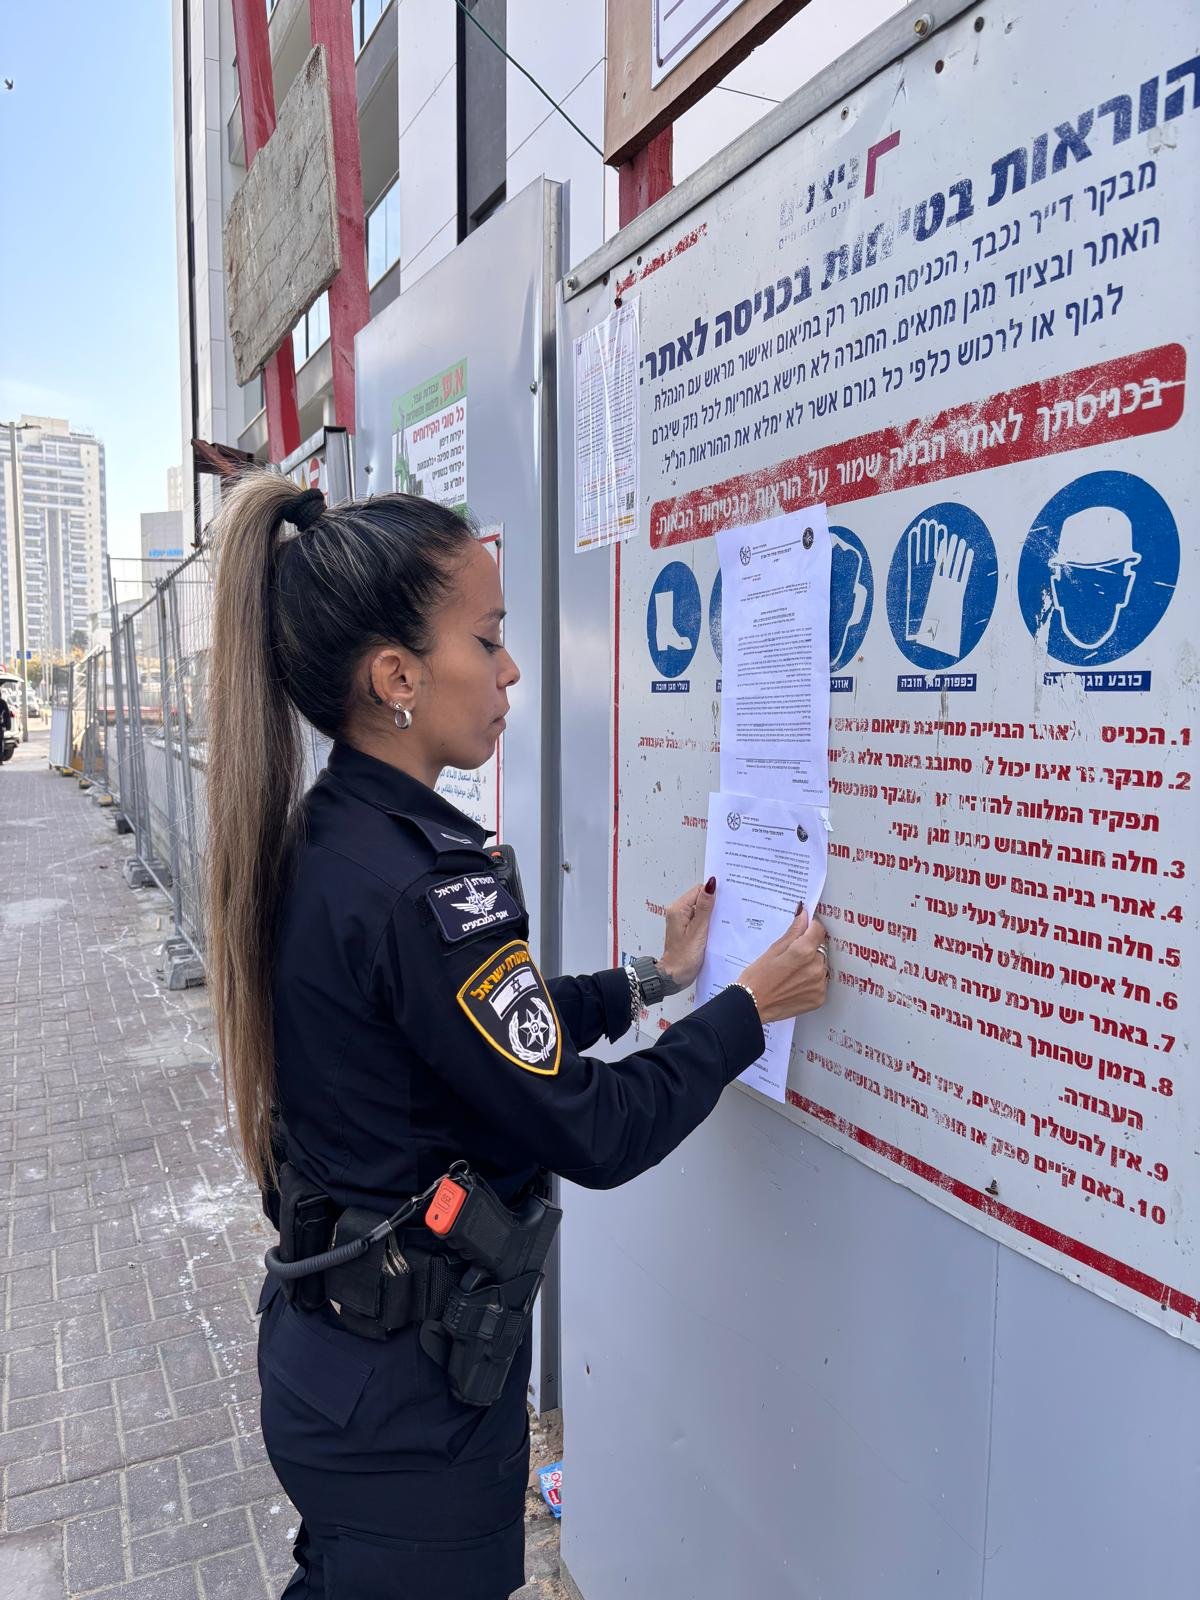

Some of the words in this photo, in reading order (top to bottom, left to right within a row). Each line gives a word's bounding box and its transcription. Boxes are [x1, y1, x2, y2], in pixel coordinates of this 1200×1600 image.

[988, 55, 1200, 206] הוראות
[1085, 161, 1156, 216] מבקר
[1030, 194, 1073, 233] דייר
[964, 220, 1020, 273] נכבד,
[1084, 217, 1159, 266] האתר
[895, 251, 957, 298] הכניסה
[1005, 250, 1072, 297] ובציוד
[715, 266, 812, 347] בכניסה
[851, 283, 888, 317] תותר
[964, 282, 995, 324] מגן
[1066, 283, 1123, 336] לגוף
[826, 304, 844, 337] רק
[893, 299, 956, 345] מתאים.
[1032, 310, 1054, 342] או
[777, 316, 820, 353] בתיאום
[958, 319, 1022, 365] לרכוש
[640, 317, 708, 385] לאתר:
[739, 339, 772, 370] ואישור
[835, 329, 886, 368] החברה
[705, 360, 734, 387] מראש
[811, 350, 829, 378] לא
[910, 350, 950, 382] כלפי
[688, 375, 700, 396] עם
[774, 364, 805, 394] תישא
[883, 367, 902, 392] כל
[655, 384, 684, 411] הנהלת
[725, 380, 768, 416] באחריות
[809, 391, 837, 419] אשר
[844, 377, 875, 408] גורם
[702, 398, 720, 424] לכל
[787, 402, 803, 428] לא
[1037, 377, 1162, 435] בכניסתך
[653, 419, 679, 445] שיגרם
[683, 412, 697, 438] נזק
[734, 426, 749, 448] את
[754, 413, 781, 440] ימלא
[958, 409, 1023, 452] לאתר
[662, 450, 685, 474] הנ"ל.
[689, 434, 730, 464] ההוראות
[836, 452, 880, 485] שמור
[808, 466, 828, 498] על
[698, 493, 749, 523] הבטיחות
[656, 507, 693, 537] הבאות:
[901, 678, 922, 688] חובה
[944, 677, 973, 688] כפפות
[1108, 674, 1142, 687] כובע
[872, 719, 910, 733] תיאום
[914, 721, 966, 736] מחייבת
[970, 721, 1024, 738] הבנייה
[1102, 726, 1165, 745] הכניס
[1171, 728, 1191, 746] 1.
[858, 749, 882, 765] אלא
[886, 753, 921, 768] באתר
[998, 757, 1030, 777] יכול
[1035, 763, 1070, 781] אינו
[1103, 768, 1163, 790] מבקר
[1168, 772, 1191, 790] 2.
[1017, 799, 1082, 824] המלווה
[1089, 809, 1159, 832] תפקיד
[927, 828, 950, 845] מגן
[994, 837, 1050, 859] לחבוש
[1057, 846, 1106, 868] חובה
[1112, 850, 1157, 875] חלה
[1164, 860, 1185, 879] 3.
[471, 876, 495, 886] משטרת
[933, 863, 980, 886] תנועת
[985, 873, 1006, 889] יש
[434, 882, 463, 898] ישראל
[1011, 877, 1048, 899] בהם
[1053, 885, 1095, 908] בניה
[495, 910, 509, 920] אגף
[962, 903, 996, 926] נעלי
[1101, 894, 1156, 919] אתרי
[1161, 905, 1183, 923] 4.
[461, 916, 496, 932] המבצעים
[857, 913, 884, 932] שיש
[1000, 910, 1049, 937] לנעול
[934, 934, 993, 963] להימצא
[1054, 925, 1102, 950] חובה
[1108, 934, 1152, 961] חלה
[504, 950, 529, 971] משטרת
[997, 950, 1054, 979] מוחלט
[1158, 948, 1180, 967] 5.
[470, 964, 505, 1000] ישראל
[961, 978, 1000, 1002] עזרה
[1060, 967, 1116, 995] איסור
[1121, 977, 1150, 1004] חל
[1006, 991, 1053, 1018] ערכת
[1156, 992, 1177, 1010] 6.
[930, 1004, 972, 1030] הבניה
[1059, 1006, 1084, 1024] יש
[977, 1019, 1022, 1048] באתר
[1089, 1014, 1148, 1046] באתר
[1027, 1035, 1092, 1070] שהותך
[1154, 1034, 1175, 1053] 7.
[907, 1061, 931, 1085] וכלי
[1098, 1059, 1146, 1088] בזמן
[1152, 1077, 1173, 1096] 8.
[1059, 1088, 1143, 1130] העבודה.
[971, 1127, 986, 1145] או
[1031, 1114, 1105, 1156] להשליך
[1034, 1155, 1075, 1187] קיים
[1111, 1146, 1141, 1172] אין
[1147, 1163, 1168, 1182] 9.
[1081, 1175, 1124, 1208] באם
[1130, 1199, 1165, 1225] 10.
